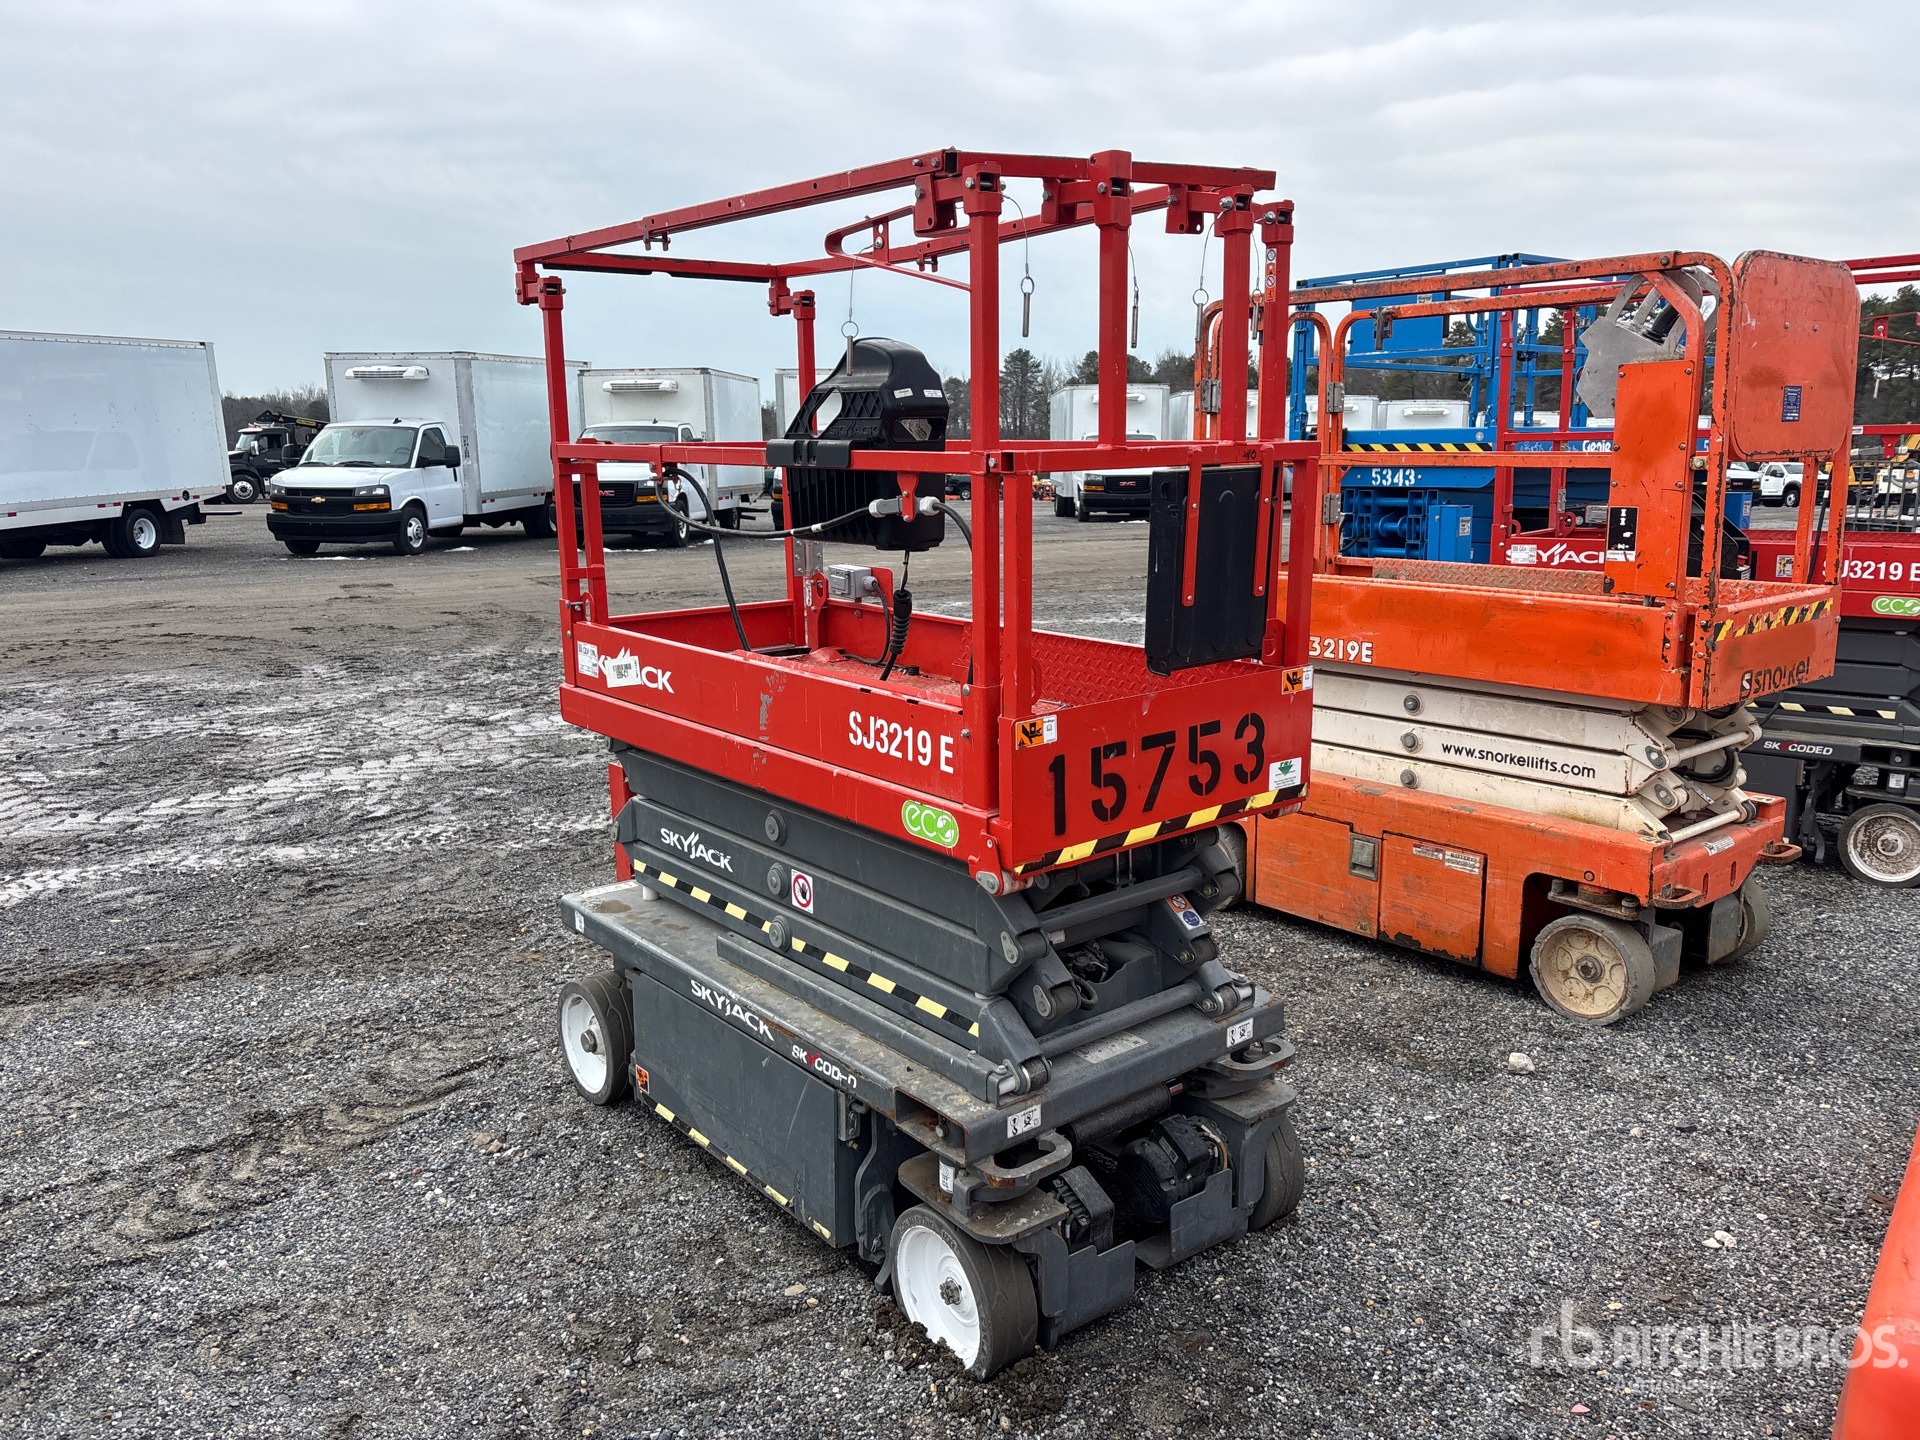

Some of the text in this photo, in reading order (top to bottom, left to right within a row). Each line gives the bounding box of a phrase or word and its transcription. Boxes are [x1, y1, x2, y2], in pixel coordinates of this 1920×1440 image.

[1371, 468, 1415, 487] 5343
[1309, 635, 1374, 664] 3219E
[848, 710, 954, 775] SJ3219 E
[1441, 743, 1596, 779] www.snorkellifts.com
[1763, 740, 1834, 756] SKYCODED
[1048, 712, 1265, 837] 15753
[904, 804, 955, 843] eco
[660, 827, 734, 873] SKYJACK
[690, 979, 775, 1042] SKYJACK
